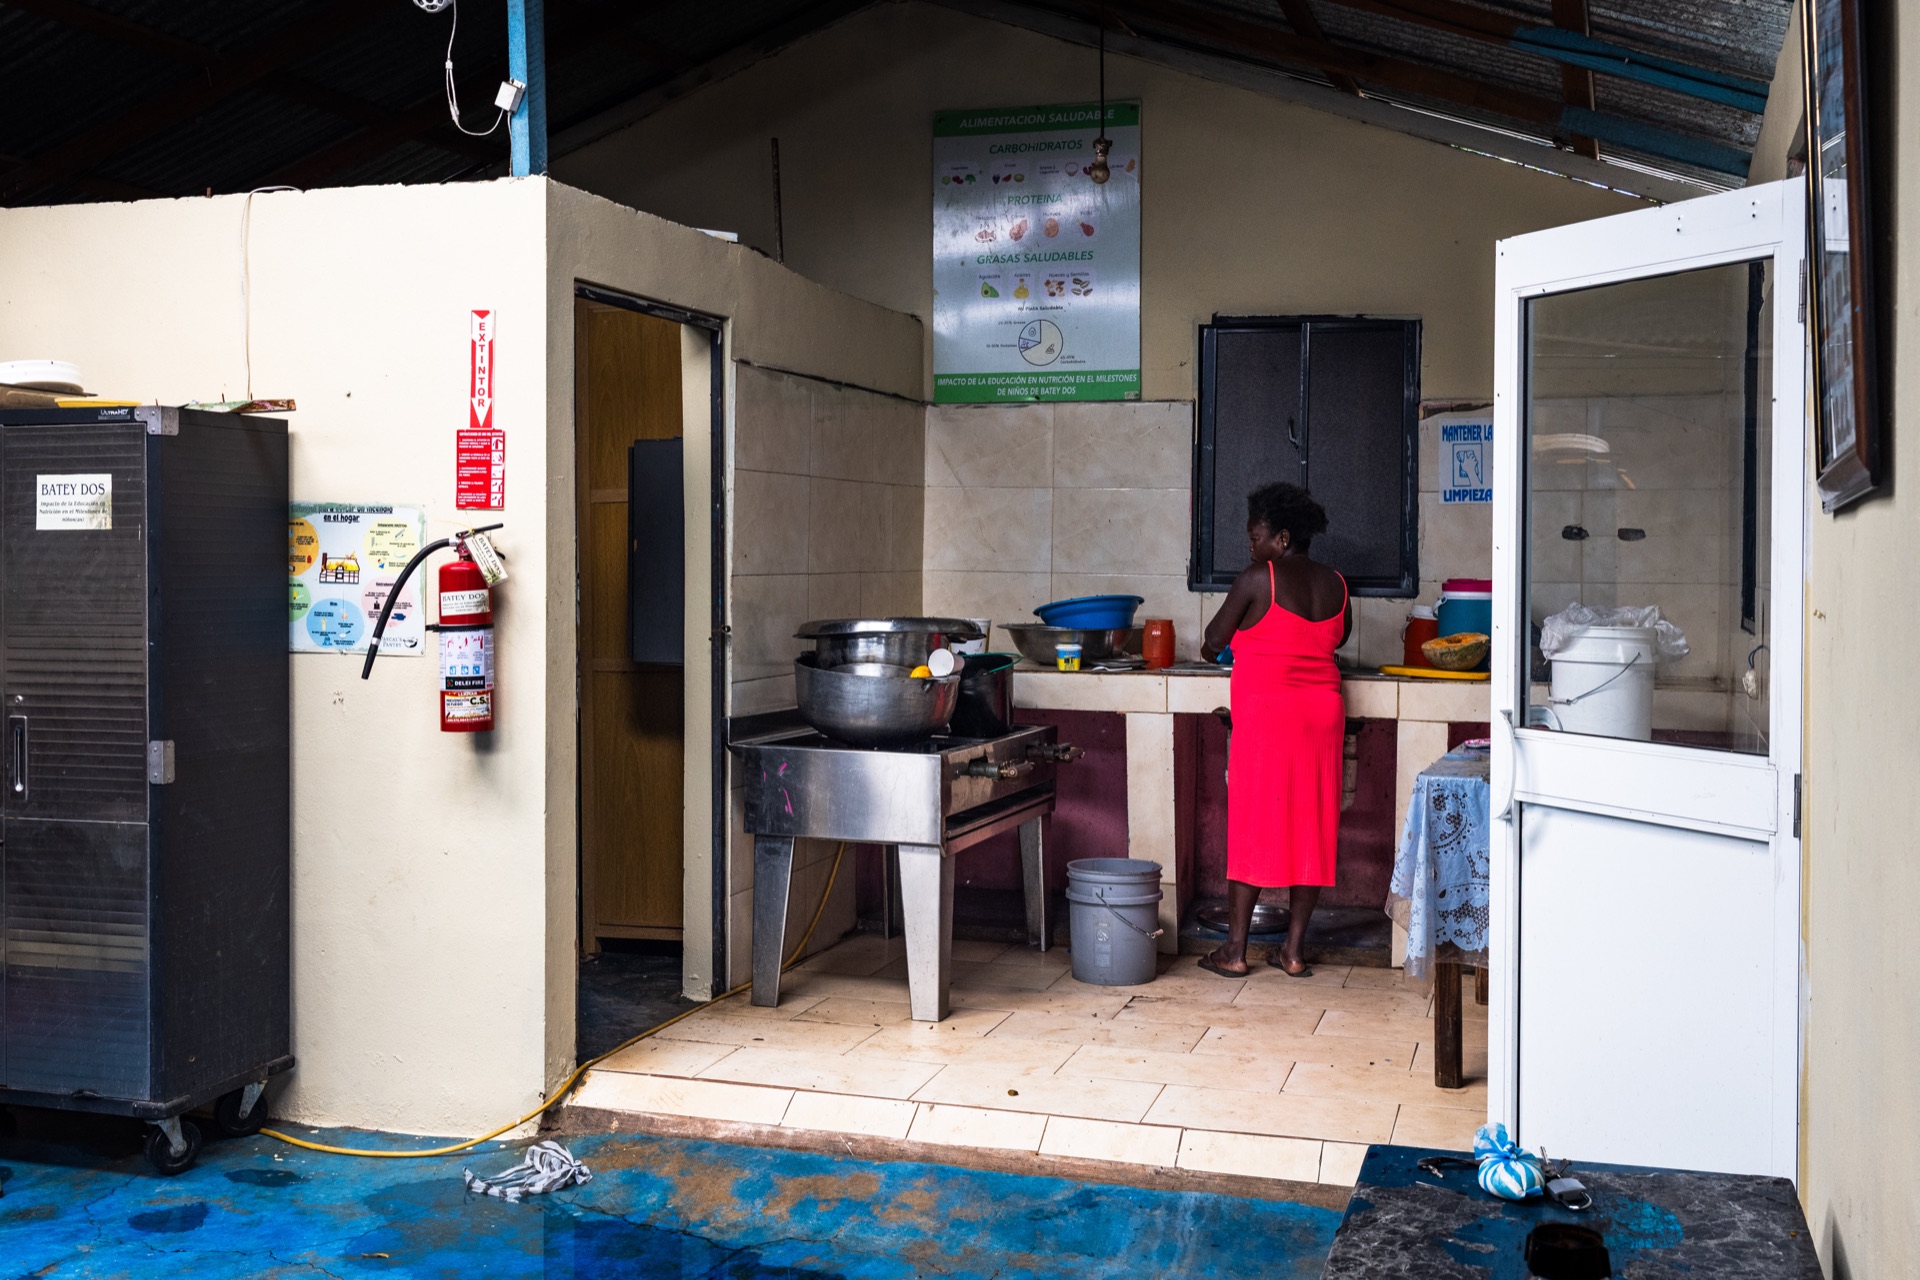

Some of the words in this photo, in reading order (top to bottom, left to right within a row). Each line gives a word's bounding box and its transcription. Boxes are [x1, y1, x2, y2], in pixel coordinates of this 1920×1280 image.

[960, 114, 1046, 128] ALIMENTACION
[1048, 110, 1115, 122] SALUDABLE
[990, 140, 1083, 154] CARBOHIDRATOS
[1008, 194, 1062, 206] PROTEINA
[977, 254, 1020, 265] GRASAS
[1024, 250, 1094, 263] SALUDABLES
[477, 322, 486, 407] EXTINTOR
[938, 377, 966, 386] IMPACTO
[968, 377, 976, 386] DE
[977, 377, 986, 385] LA
[988, 375, 1026, 385] EDUCACIÓN
[1028, 376, 1037, 384] EN
[1038, 374, 1074, 384] NUTRICIÓN
[1076, 375, 1085, 383] EN
[1087, 375, 1095, 383] EL
[1096, 374, 1137, 382] MILESTONES
[997, 388, 1006, 396] DE
[1008, 386, 1028, 396] NIÑOS
[1030, 387, 1039, 395] DE
[1040, 387, 1058, 395] BATEY
[1060, 387, 1076, 395] DOS
[1442, 424, 1482, 443] MANTENER
[1484, 425, 1493, 442] LA
[41, 483, 77, 496] BATEY
[81, 483, 105, 496] DOS
[1444, 489, 1492, 502] LIMPIEZA
[341, 514, 360, 523] hogar
[478, 537, 493, 559] BATEY
